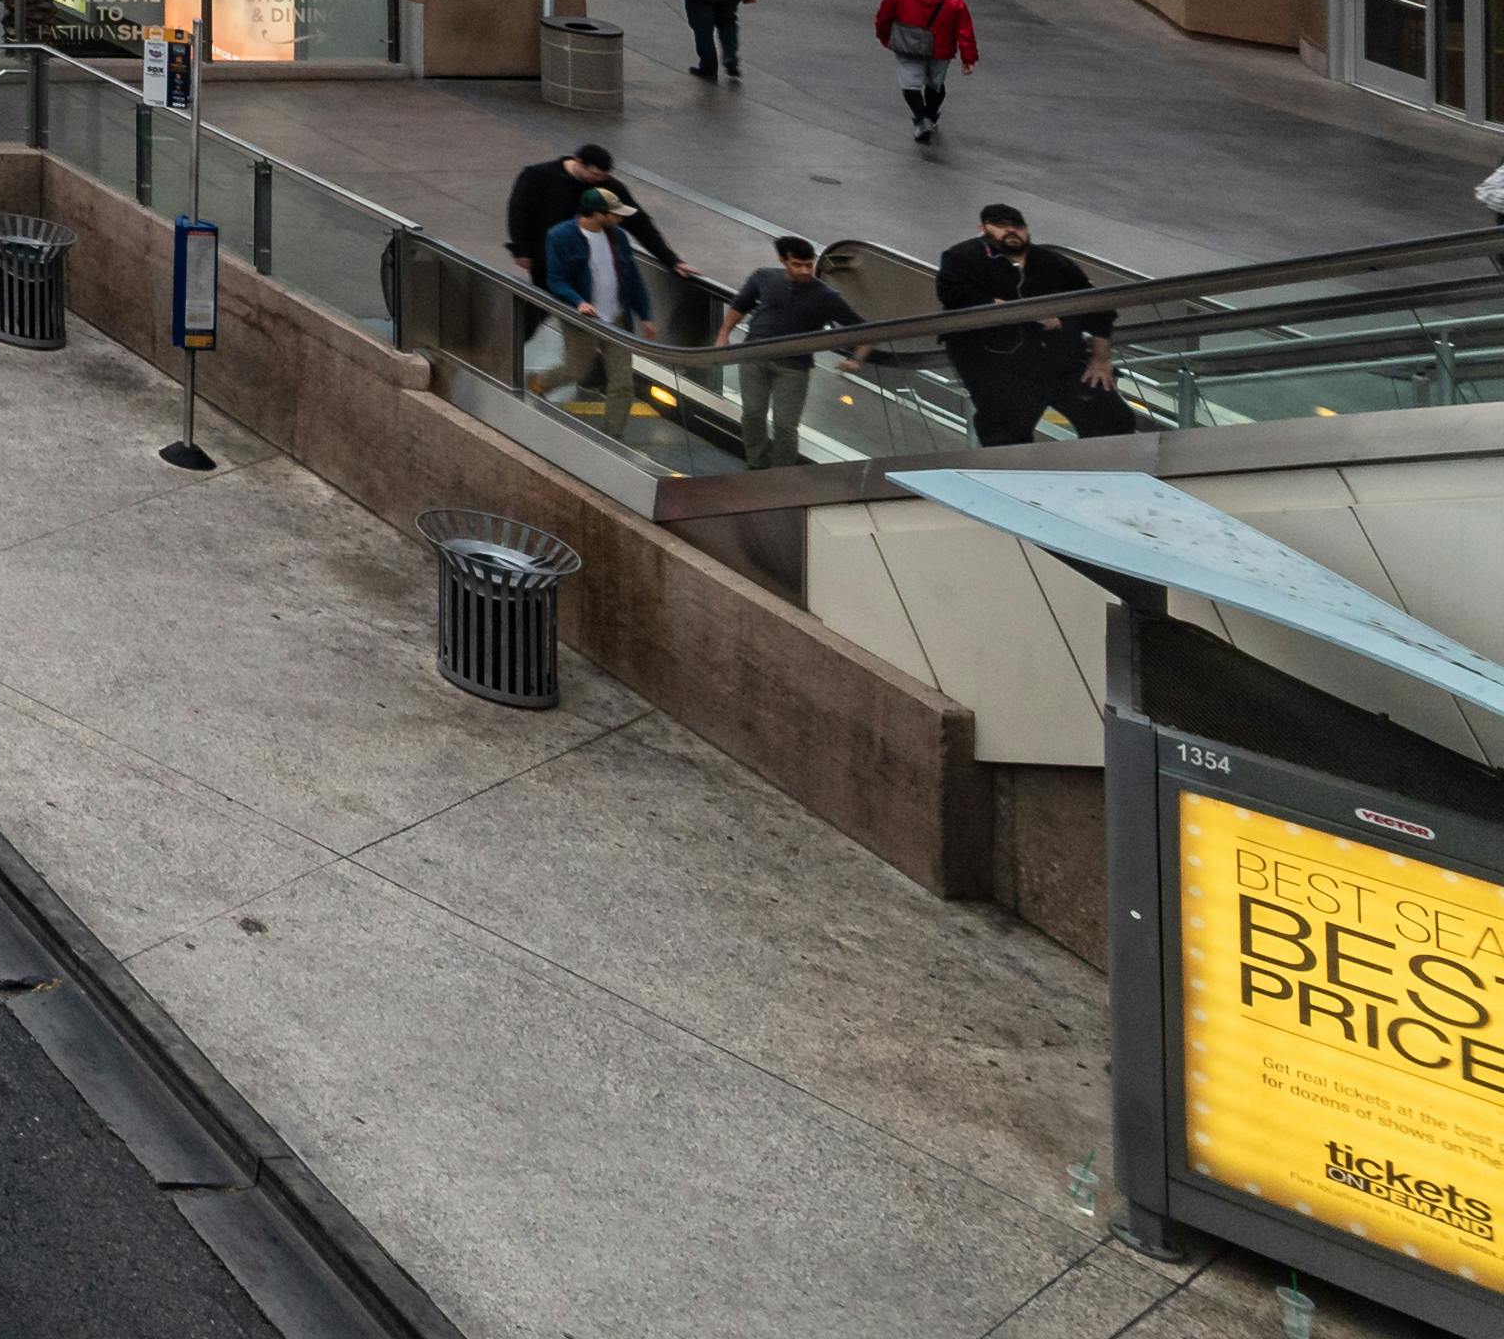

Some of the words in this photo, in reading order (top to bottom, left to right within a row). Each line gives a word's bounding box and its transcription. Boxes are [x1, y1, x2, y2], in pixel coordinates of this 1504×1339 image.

[96, 7, 123, 22] TO
[252, 9, 264, 23] &
[1177, 743, 1232, 774] 1354
[1362, 810, 1431, 837] VECTOR
[1237, 848, 1376, 923] BEST
[1239, 893, 1504, 1029] BES
[1240, 961, 1504, 1093] PRICE
[1262, 1073, 1285, 1091] for
[1290, 1081, 1351, 1114] dozens
[1355, 1106, 1372, 1121] of
[1378, 1115, 1436, 1144] shows
[1442, 1140, 1464, 1155] on
[1263, 1056, 1289, 1076] Get
[1296, 1070, 1328, 1088] real
[1333, 1080, 1391, 1110] tickets
[1397, 1105, 1414, 1119] at
[1420, 1112, 1448, 1131] the
[1325, 1140, 1492, 1222] tickets
[1327, 1166, 1366, 1191] ON
[1368, 1180, 1492, 1240] DEMAND
